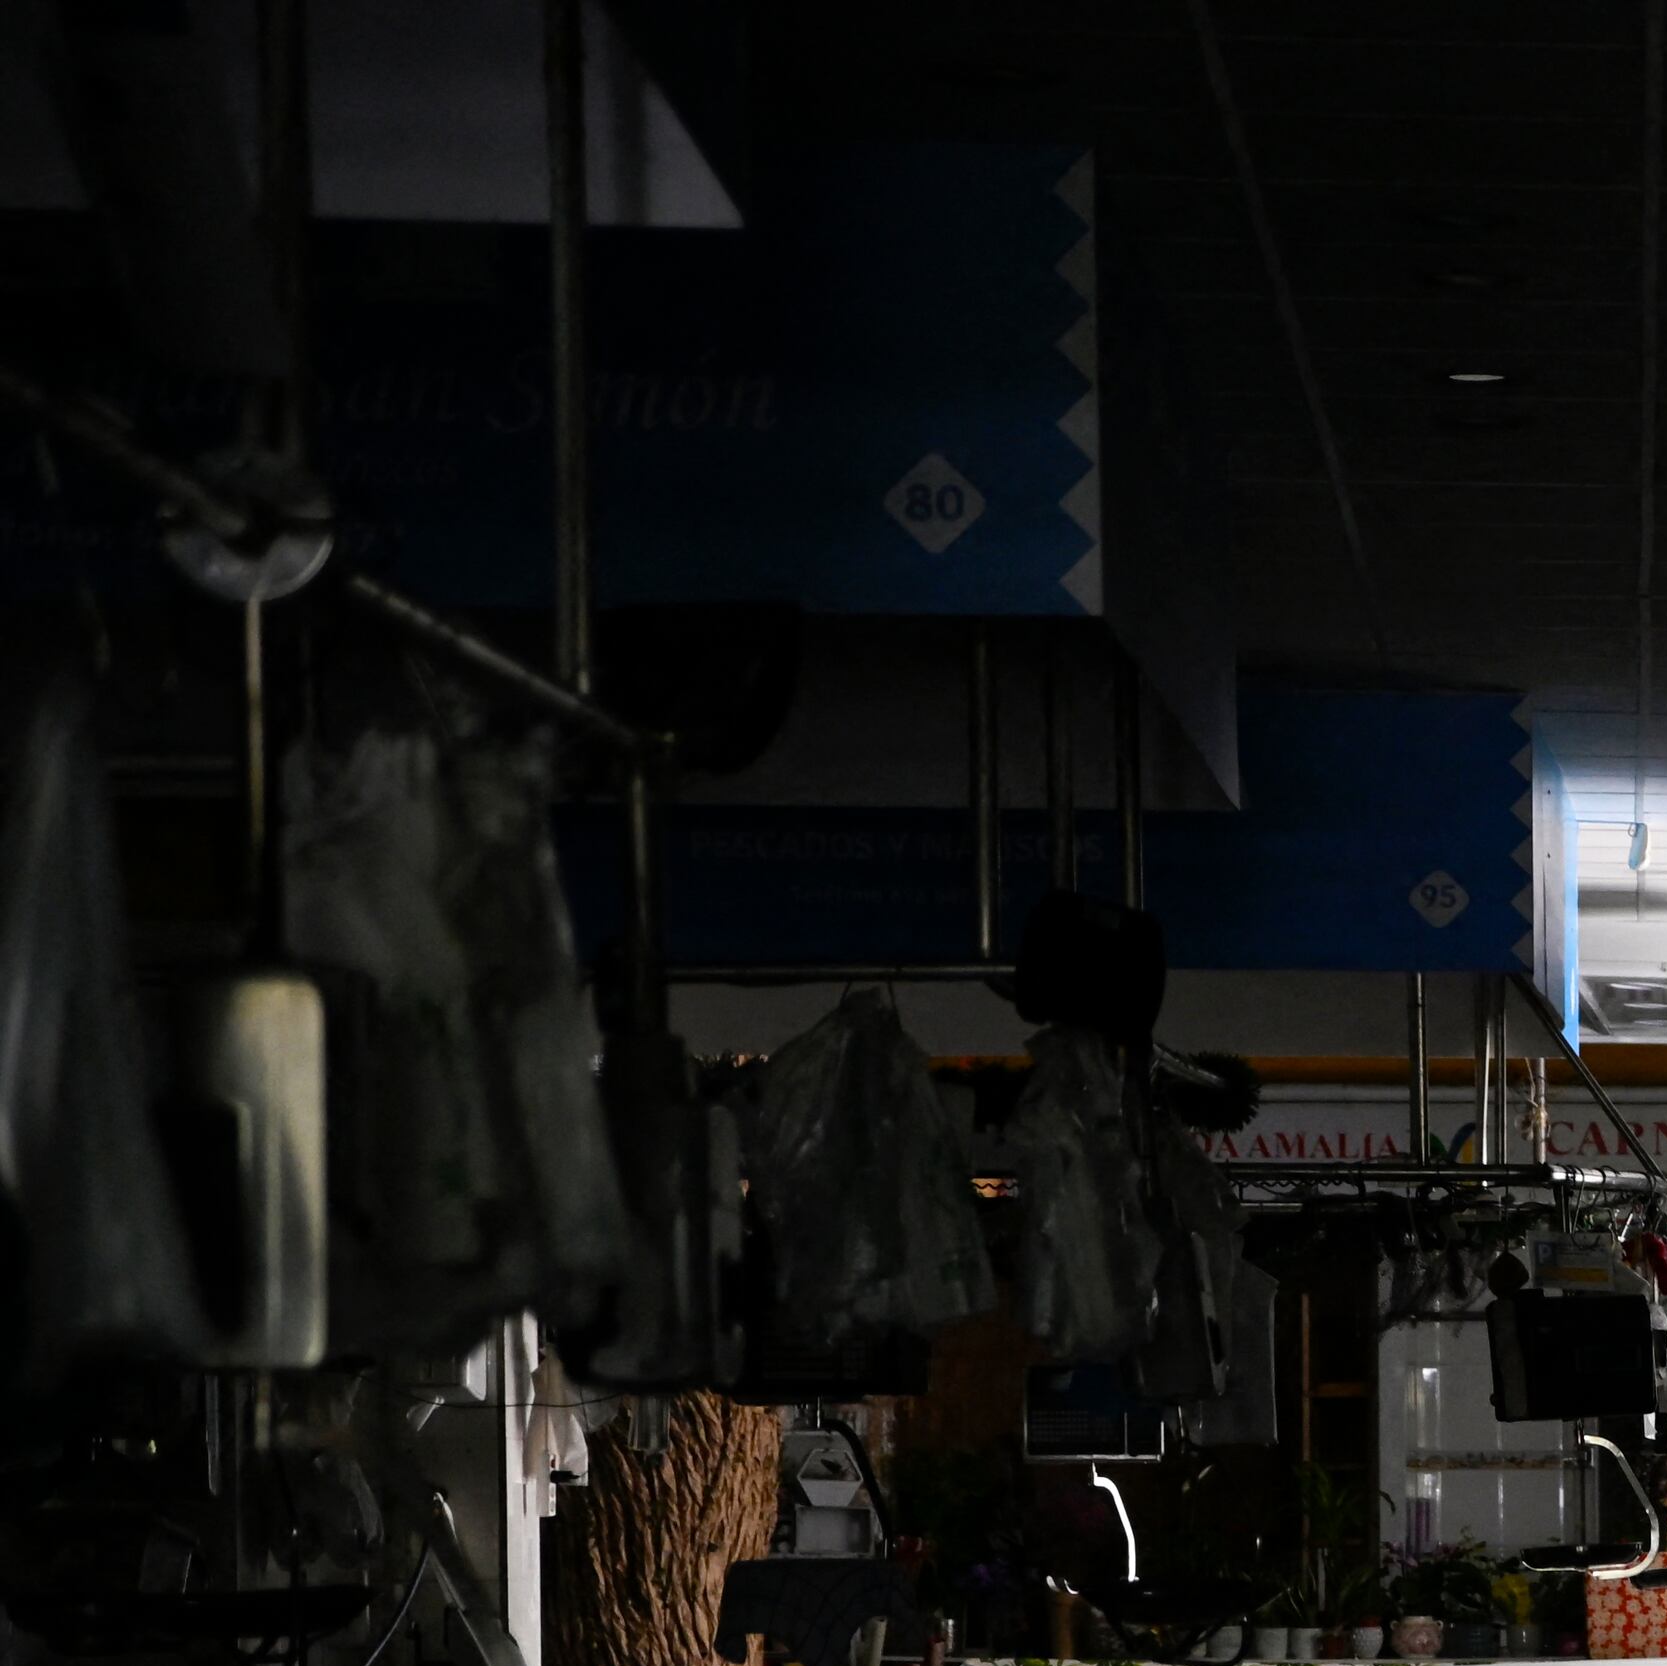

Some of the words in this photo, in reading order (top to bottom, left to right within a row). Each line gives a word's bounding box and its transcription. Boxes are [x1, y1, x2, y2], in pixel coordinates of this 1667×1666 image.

[484, 345, 778, 433] Smón
[905, 484, 964, 522] 80
[921, 831, 1106, 864] MAISCS
[1420, 884, 1457, 908] 95
[1247, 1132, 1403, 1160] AMALIA
